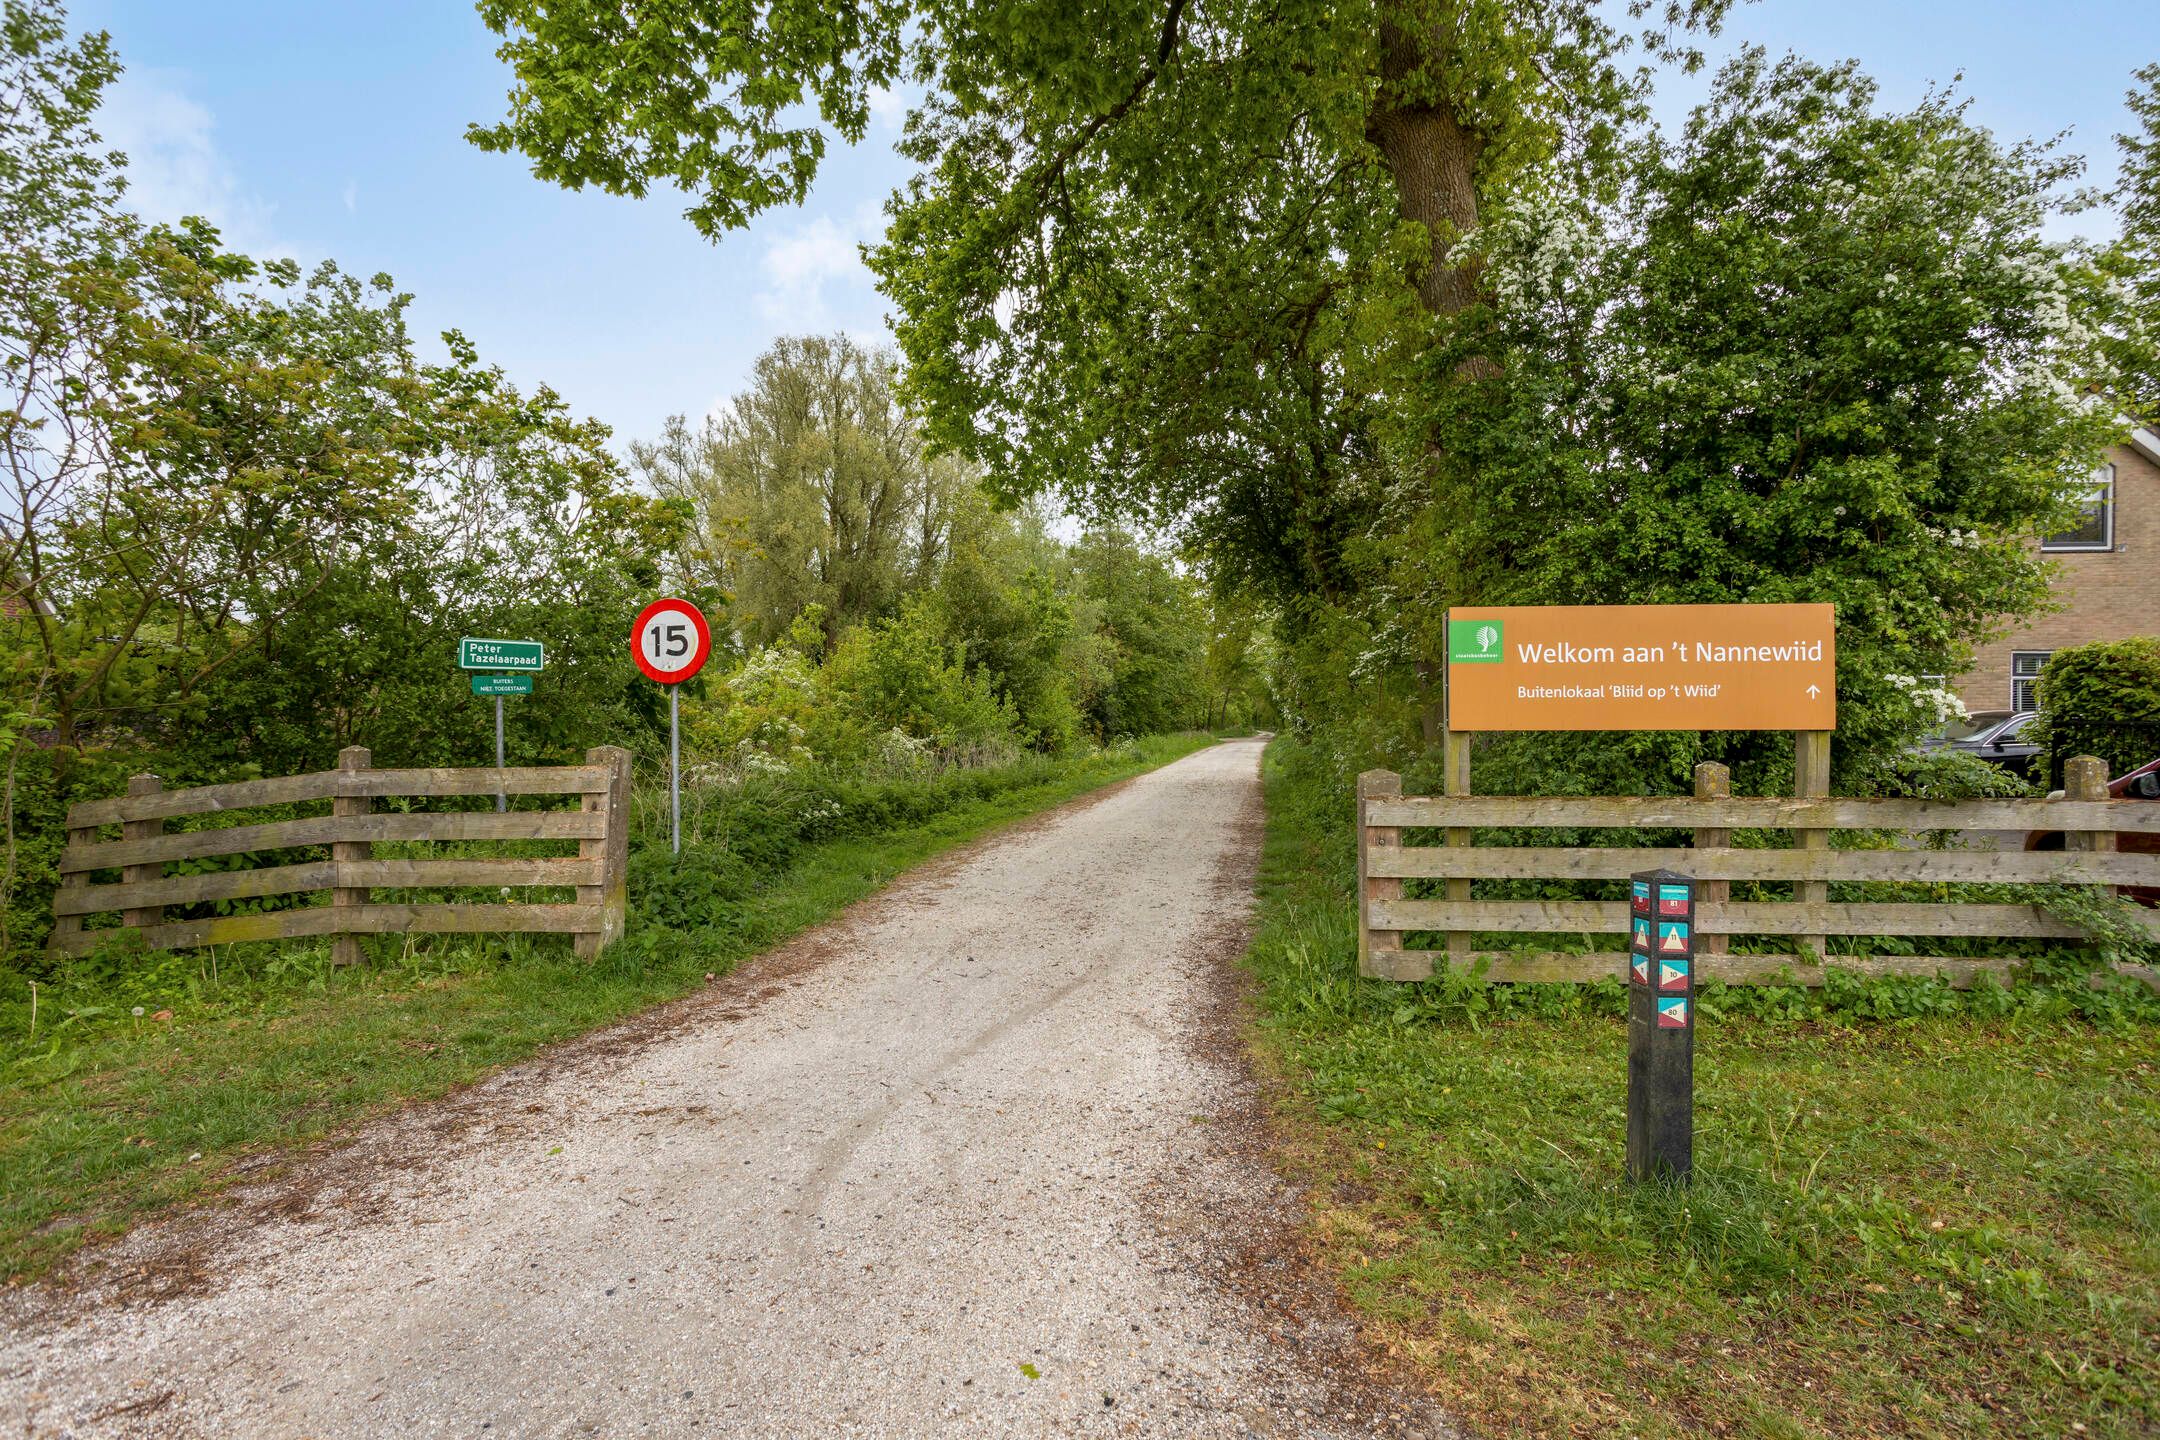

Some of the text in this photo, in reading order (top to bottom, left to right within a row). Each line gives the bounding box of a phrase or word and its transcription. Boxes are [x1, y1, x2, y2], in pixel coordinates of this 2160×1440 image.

[470, 643, 502, 653] Peter
[651, 625, 688, 657] 15
[1517, 642, 1615, 663] Welkom
[1622, 646, 1664, 663] aan
[1695, 640, 1823, 662] Nannewiid
[470, 653, 537, 666] Tazelaarpaad
[1517, 685, 1604, 698] Buitenlokaal
[1648, 688, 1666, 700] op
